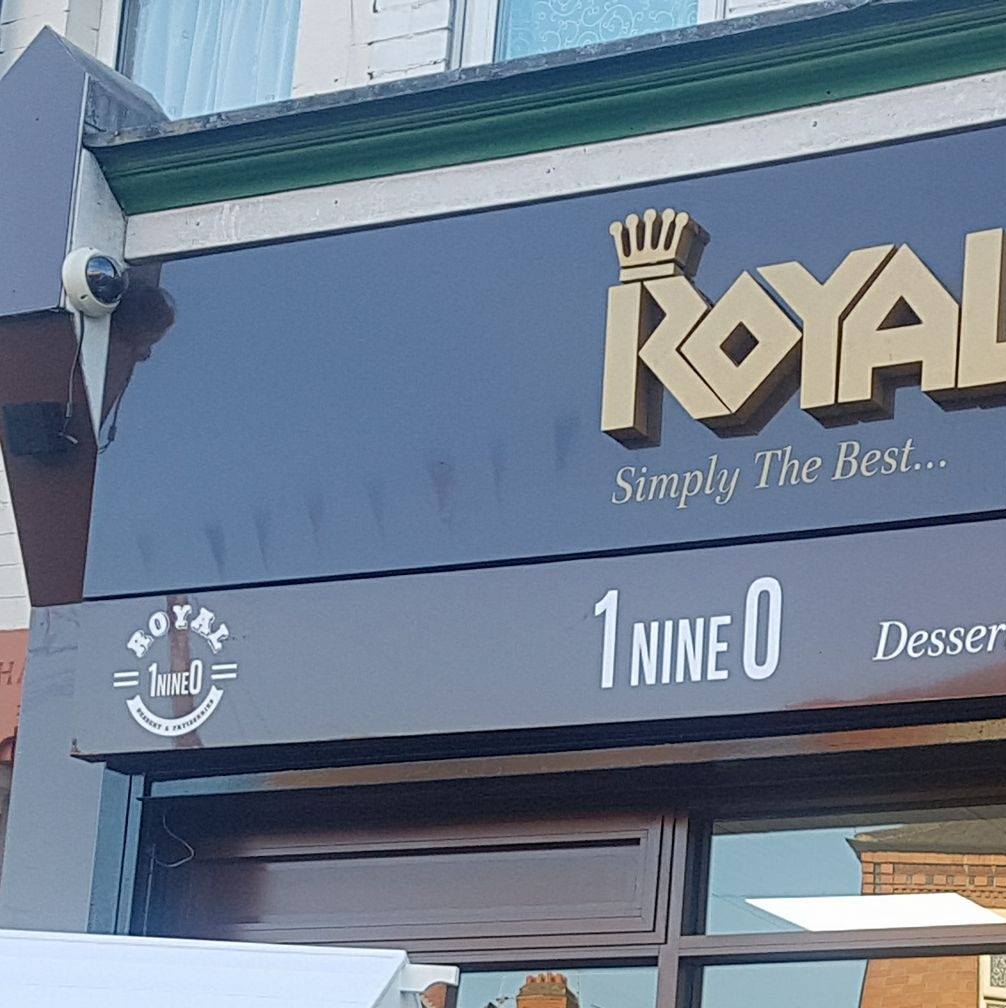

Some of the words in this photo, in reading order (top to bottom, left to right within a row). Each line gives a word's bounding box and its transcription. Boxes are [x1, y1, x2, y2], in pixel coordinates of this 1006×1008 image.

[611, 454, 740, 510] Simply
[754, 444, 822, 490] The
[831, 437, 948, 481] Best...
[127, 604, 230, 658] ROYAL
